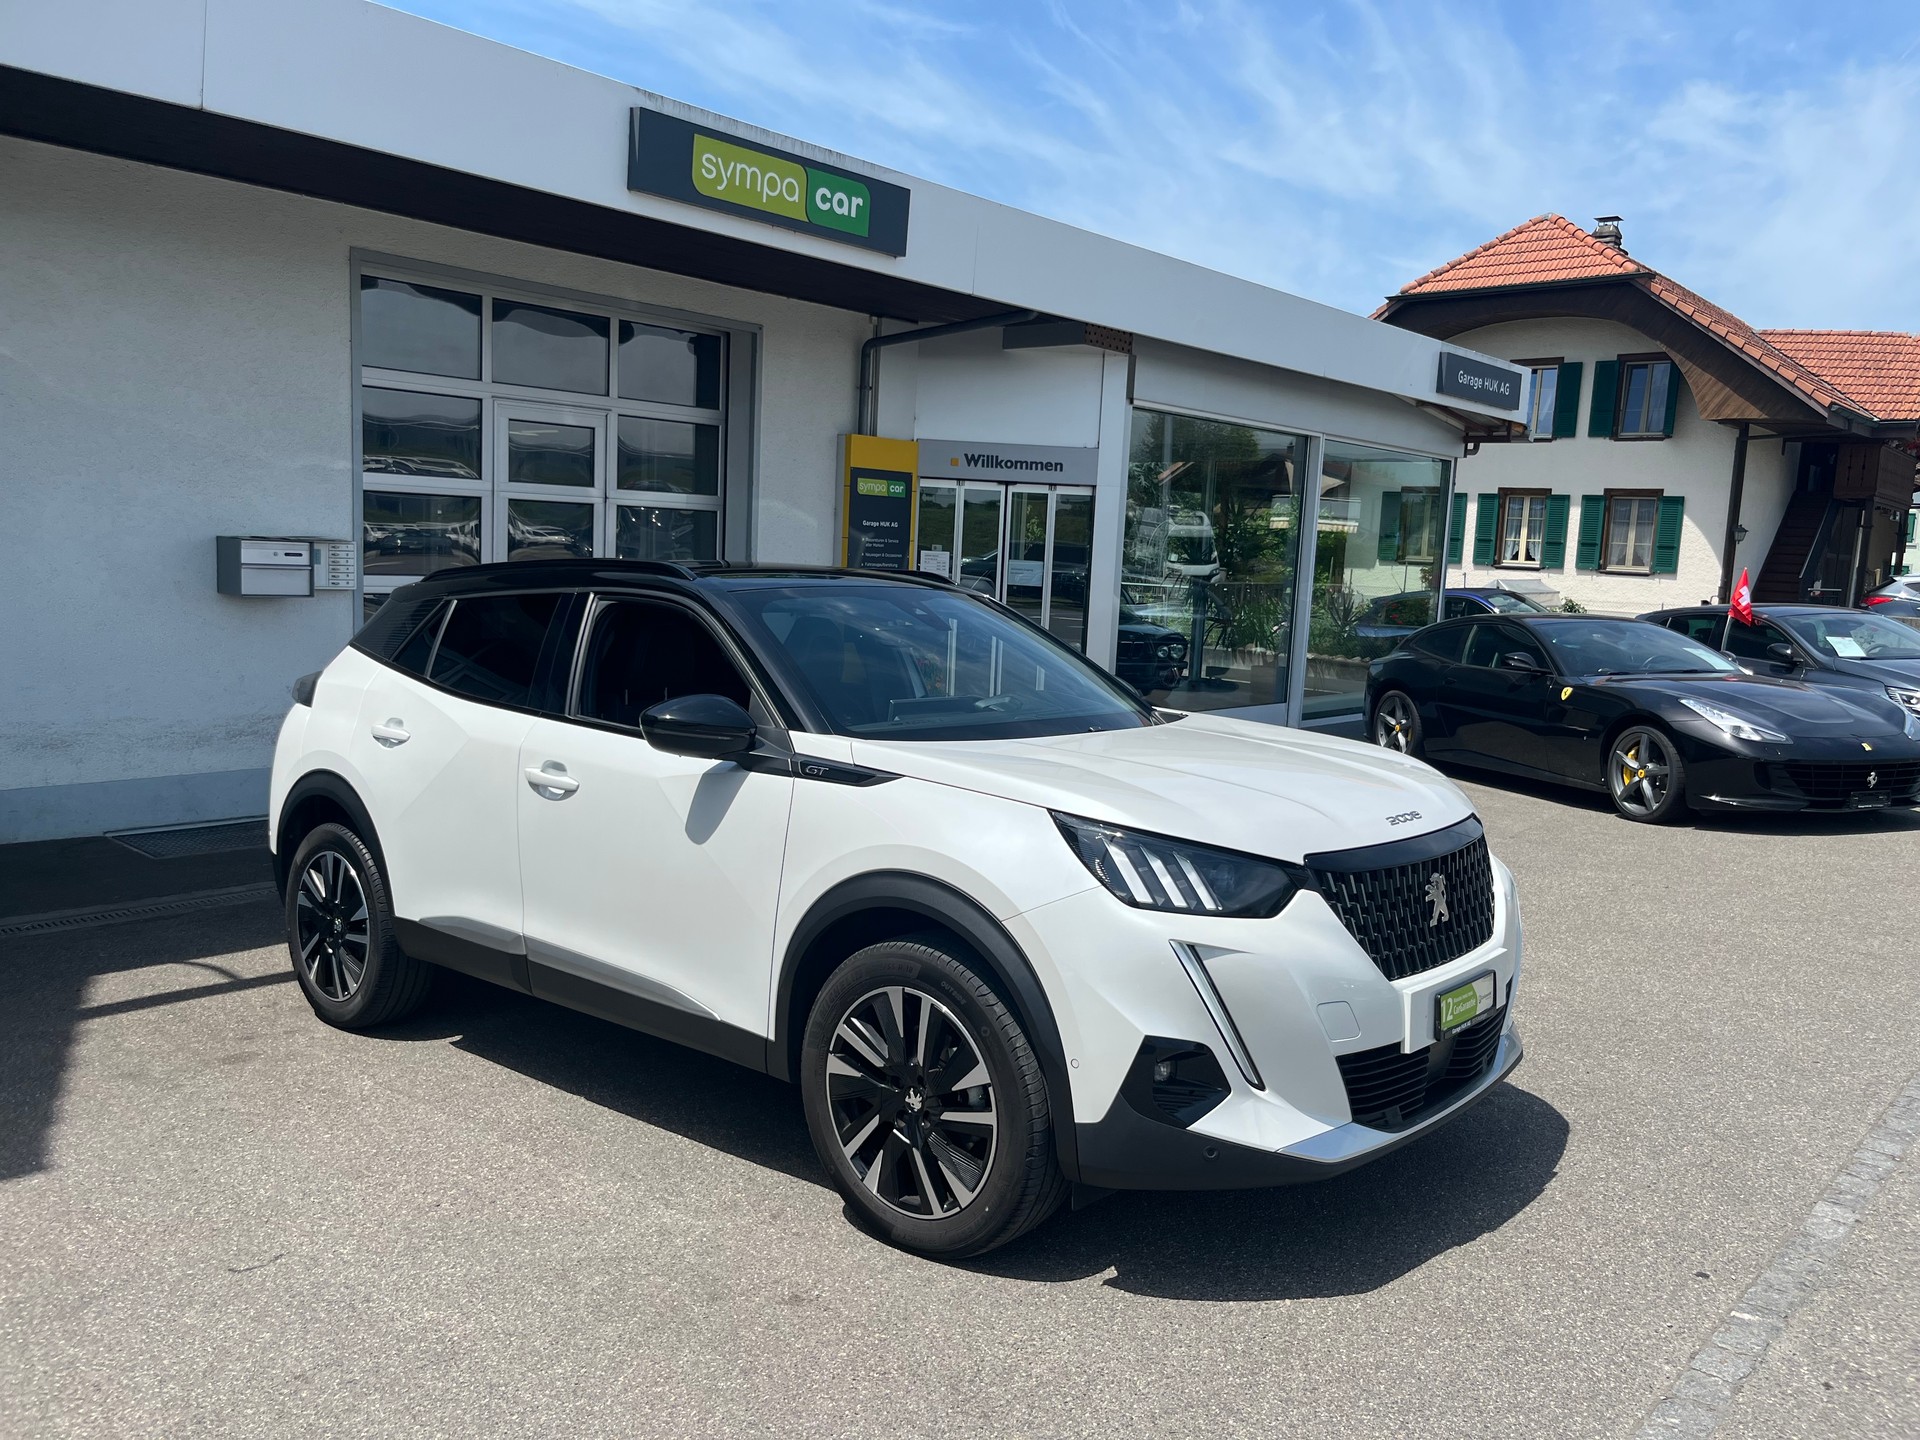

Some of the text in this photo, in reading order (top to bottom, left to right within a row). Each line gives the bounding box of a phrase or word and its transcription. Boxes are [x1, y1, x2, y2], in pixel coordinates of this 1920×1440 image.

[701, 153, 863, 218] sympa car
[1458, 370, 1510, 395] Garage HUK AG
[964, 453, 1063, 472] Willkommen
[859, 481, 904, 493] sympa car
[862, 520, 879, 528] Garage
[806, 765, 829, 776] GT
